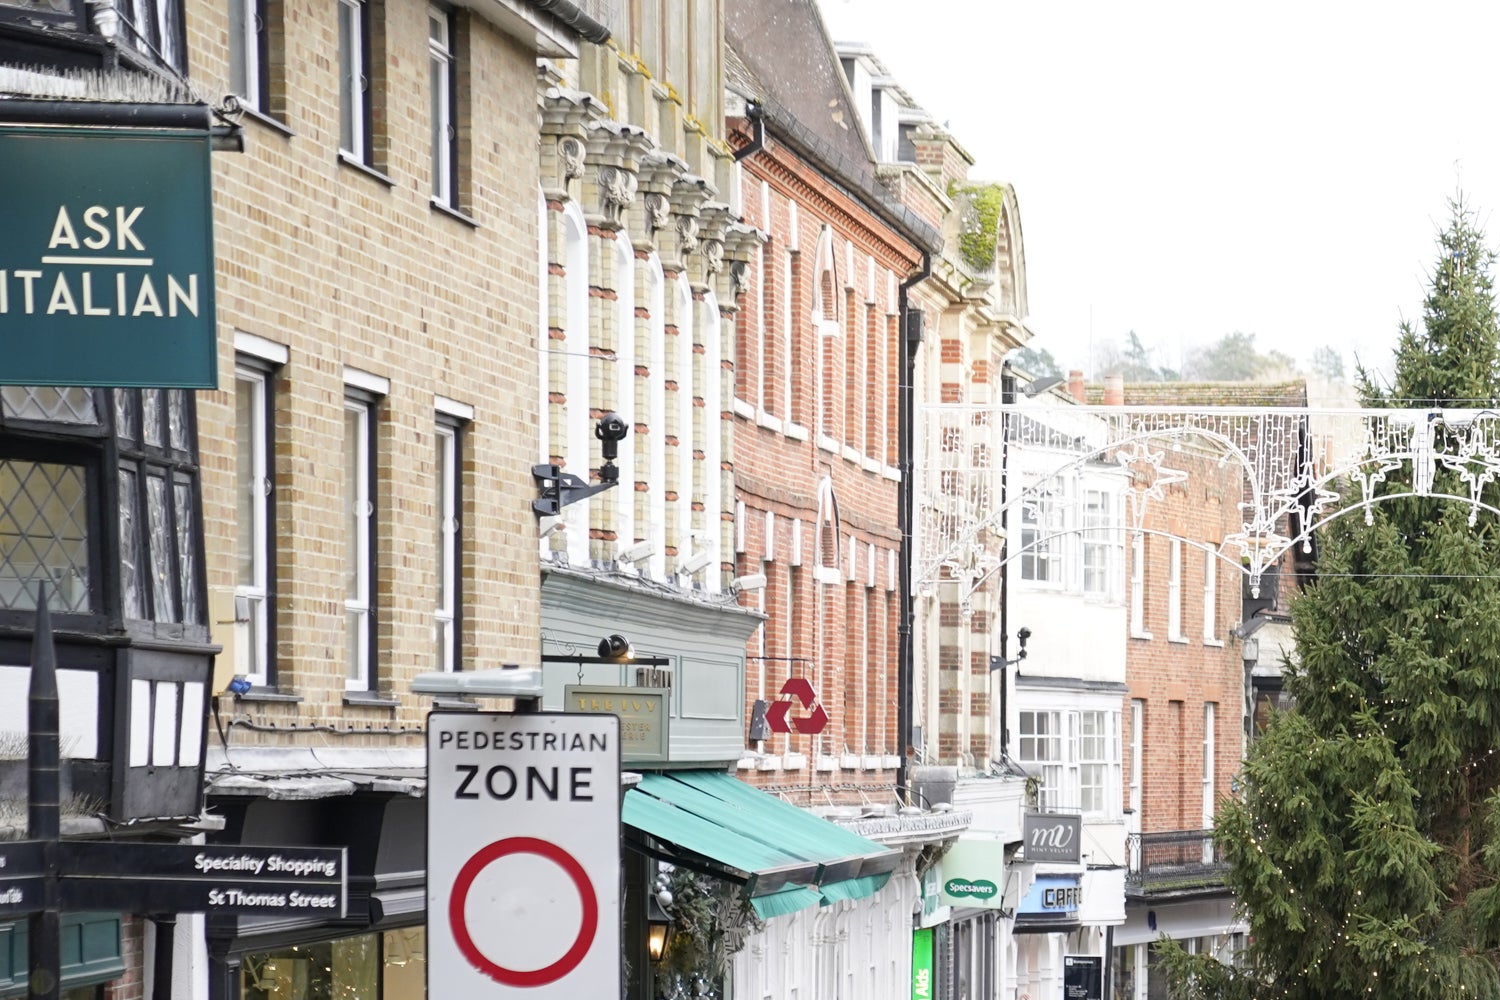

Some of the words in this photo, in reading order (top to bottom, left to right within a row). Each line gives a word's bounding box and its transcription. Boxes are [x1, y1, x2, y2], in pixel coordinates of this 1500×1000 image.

[48, 205, 146, 250] ASK
[0, 269, 199, 318] ITALIAN
[578, 699, 612, 711] THE
[621, 700, 656, 712] IVY
[439, 731, 607, 752] PEDESTRIAN
[455, 764, 594, 802] ZONE
[194, 854, 264, 875] Speciality
[267, 855, 336, 876] Shopping
[208, 890, 226, 905] St
[226, 891, 286, 907] Thomas
[289, 892, 336, 908] Street
[950, 882, 993, 895] Specsavers
[916, 968, 929, 997] Aids
